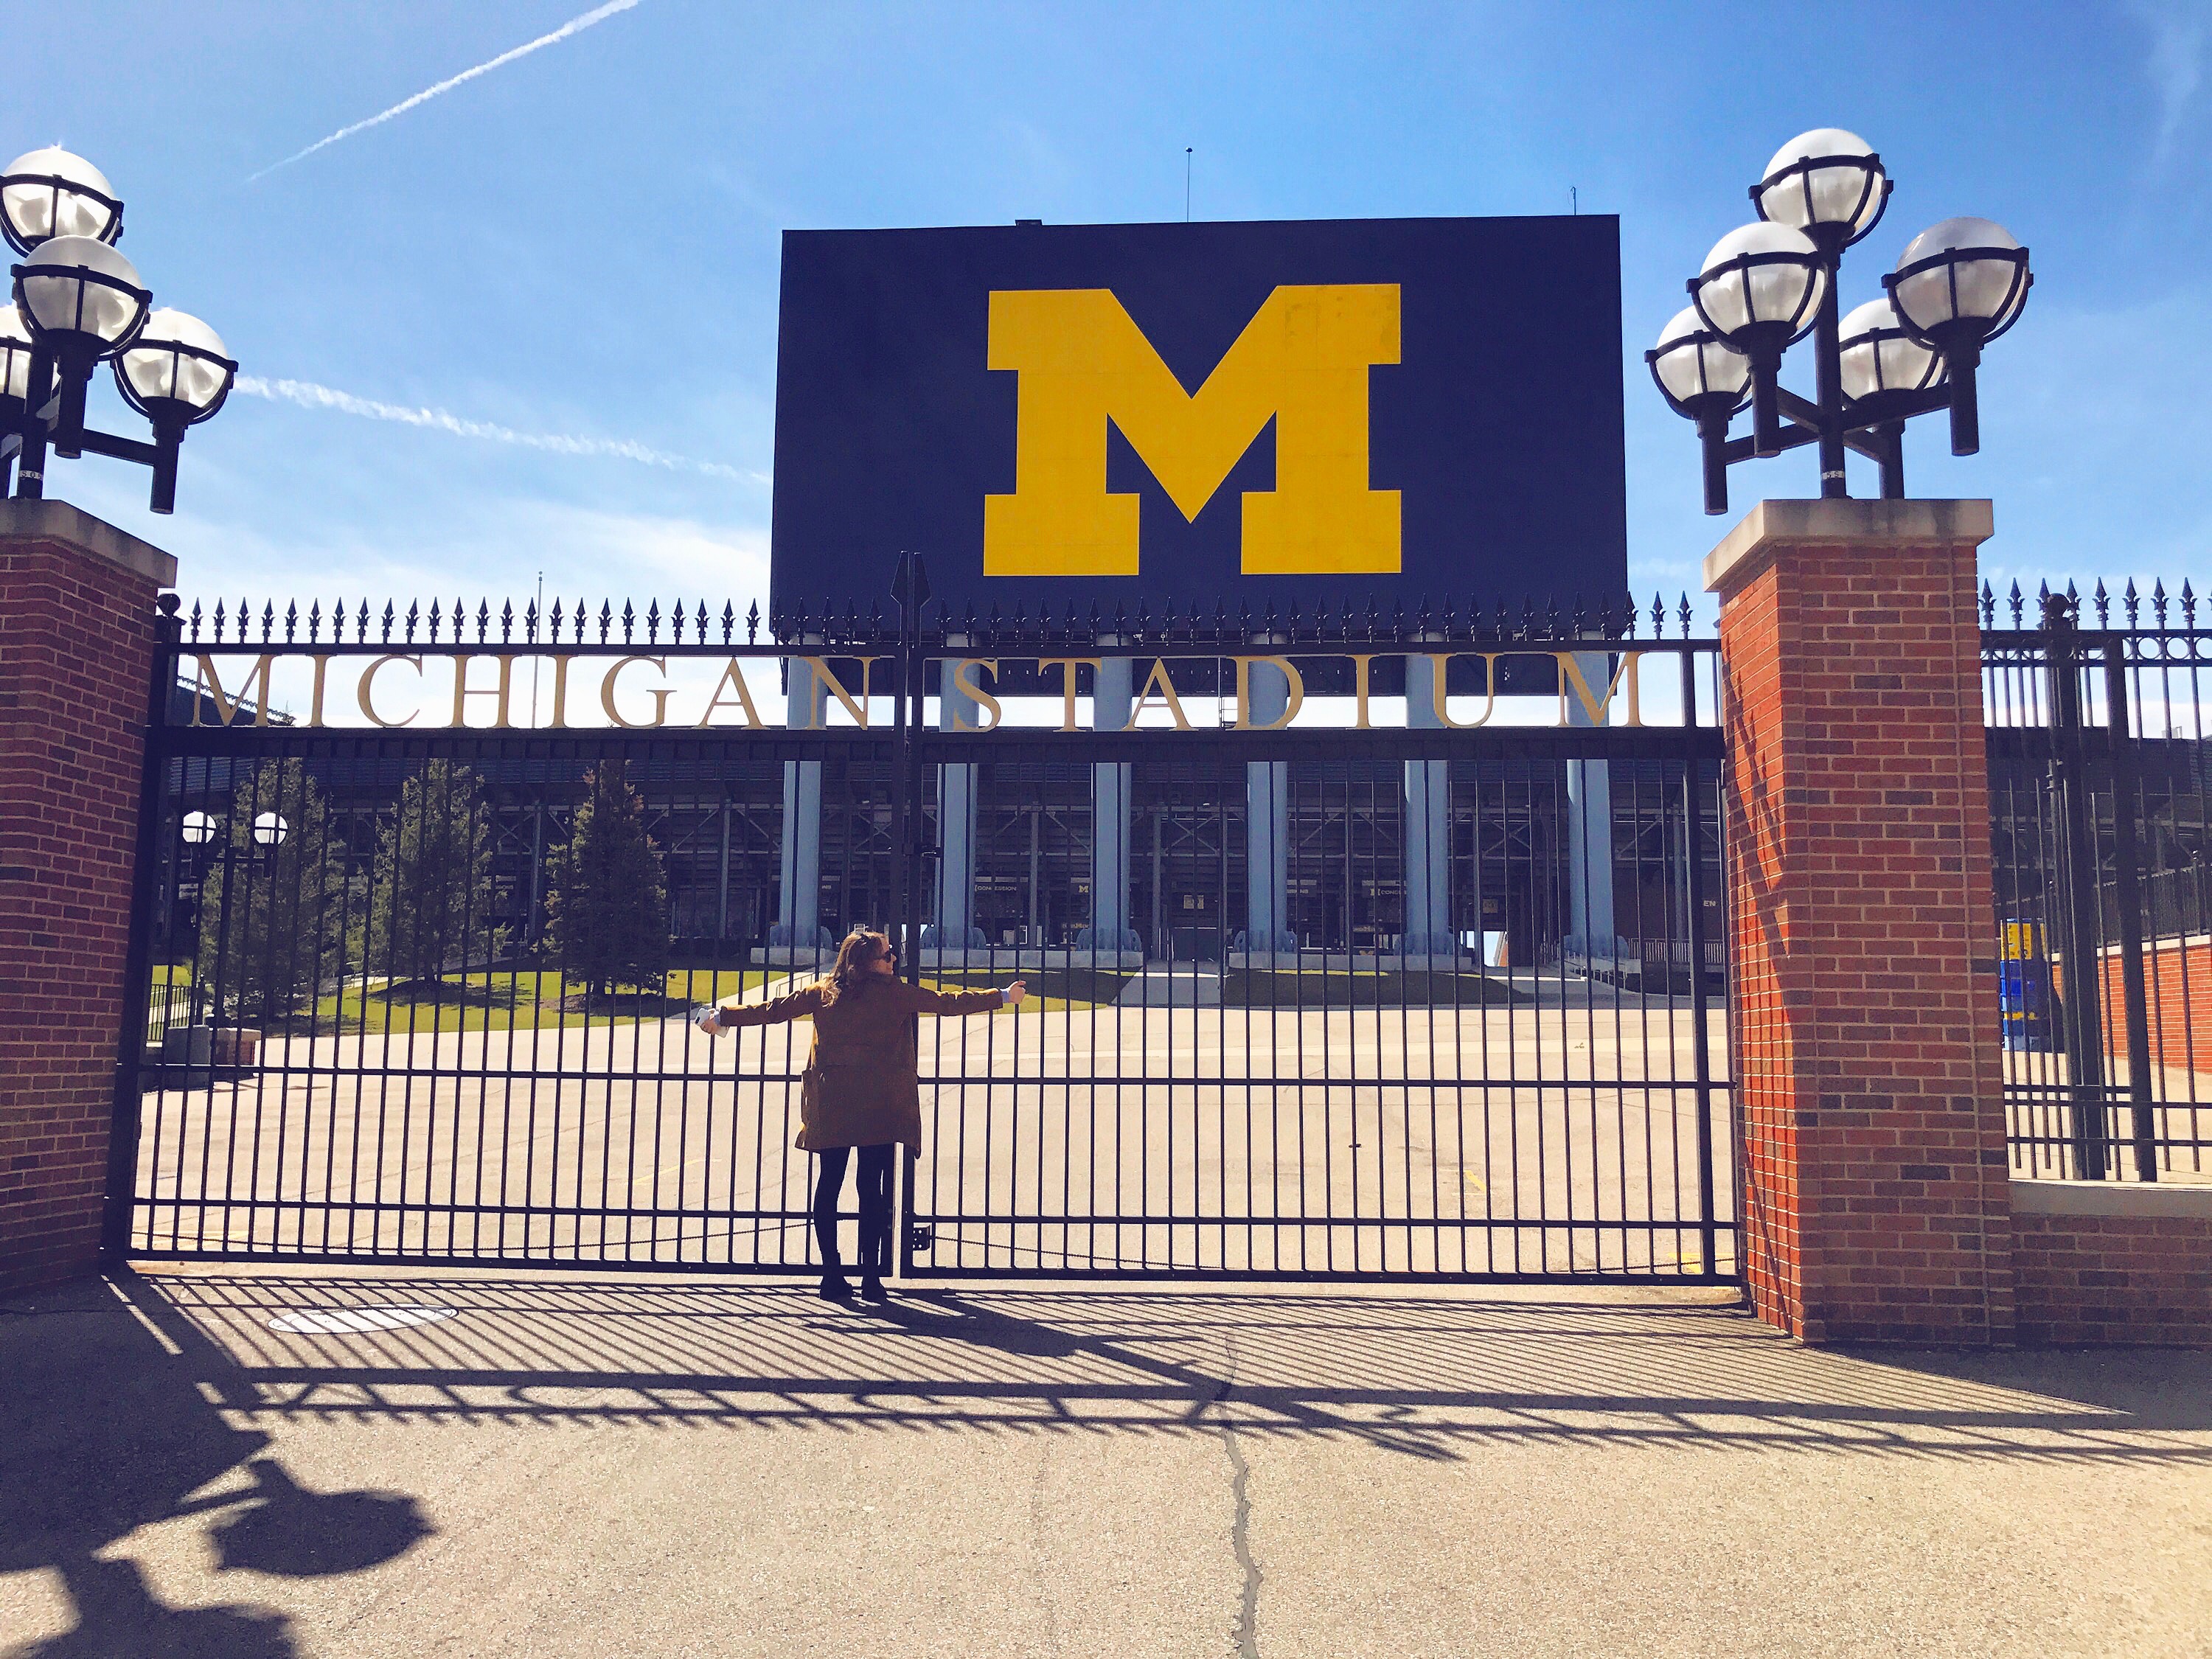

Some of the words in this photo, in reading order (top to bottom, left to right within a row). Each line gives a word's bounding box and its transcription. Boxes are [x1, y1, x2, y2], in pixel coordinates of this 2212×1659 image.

[984, 284, 1401, 575] M
[189, 653, 881, 731] MICHIGAN
[953, 651, 1647, 732] STADIUM
